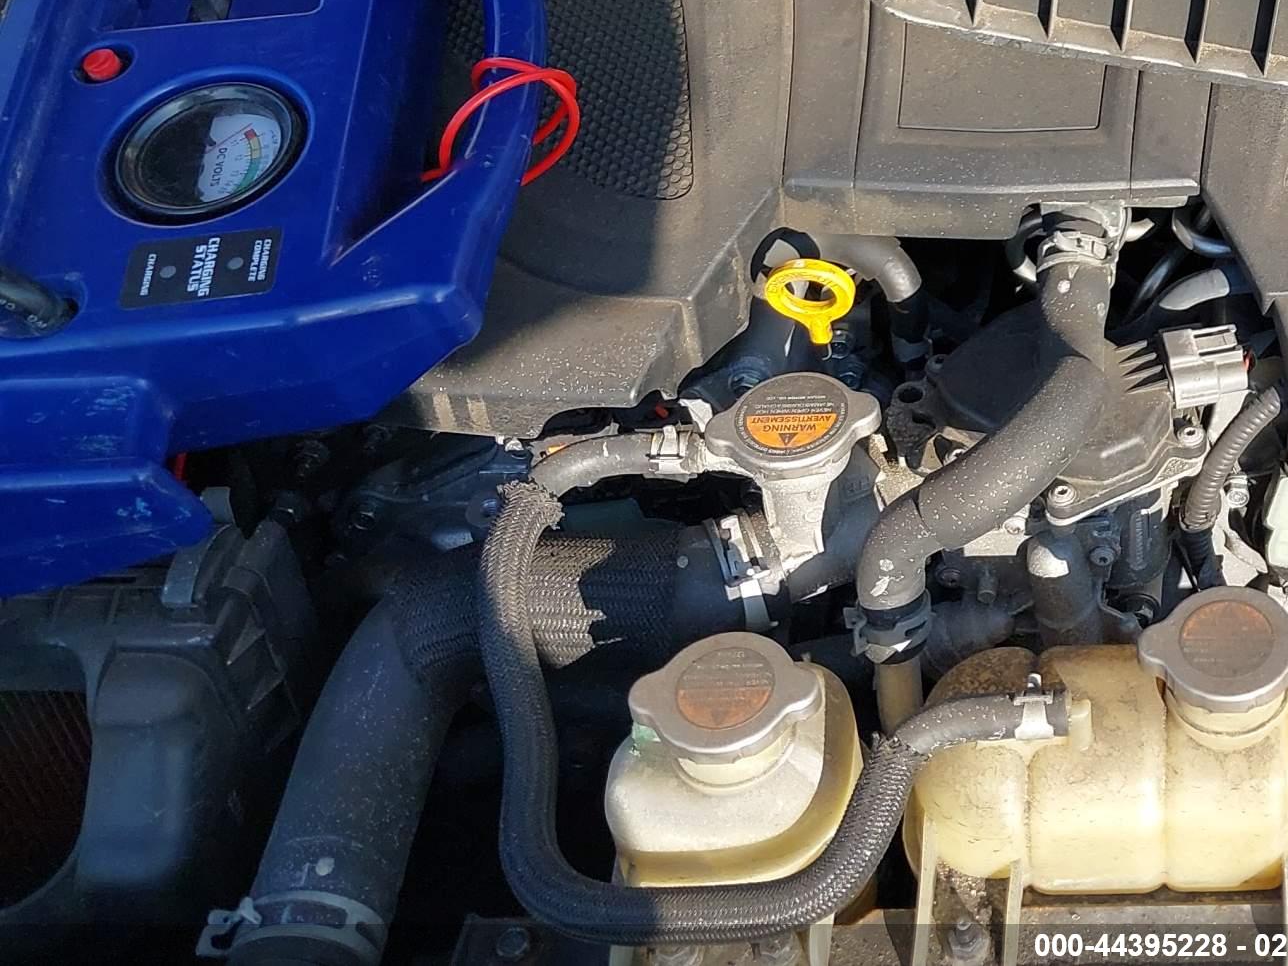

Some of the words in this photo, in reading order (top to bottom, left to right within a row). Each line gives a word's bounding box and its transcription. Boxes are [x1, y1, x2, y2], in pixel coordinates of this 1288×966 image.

[139, 253, 157, 296] CHARGING
[186, 244, 208, 292] STATUS
[197, 236, 221, 297] CHARGING
[247, 239, 263, 282] COMPLETE
[256, 238, 273, 281] CHARGING
[751, 415, 832, 424] AVERTISSEMENT
[762, 424, 817, 432] WARNING
